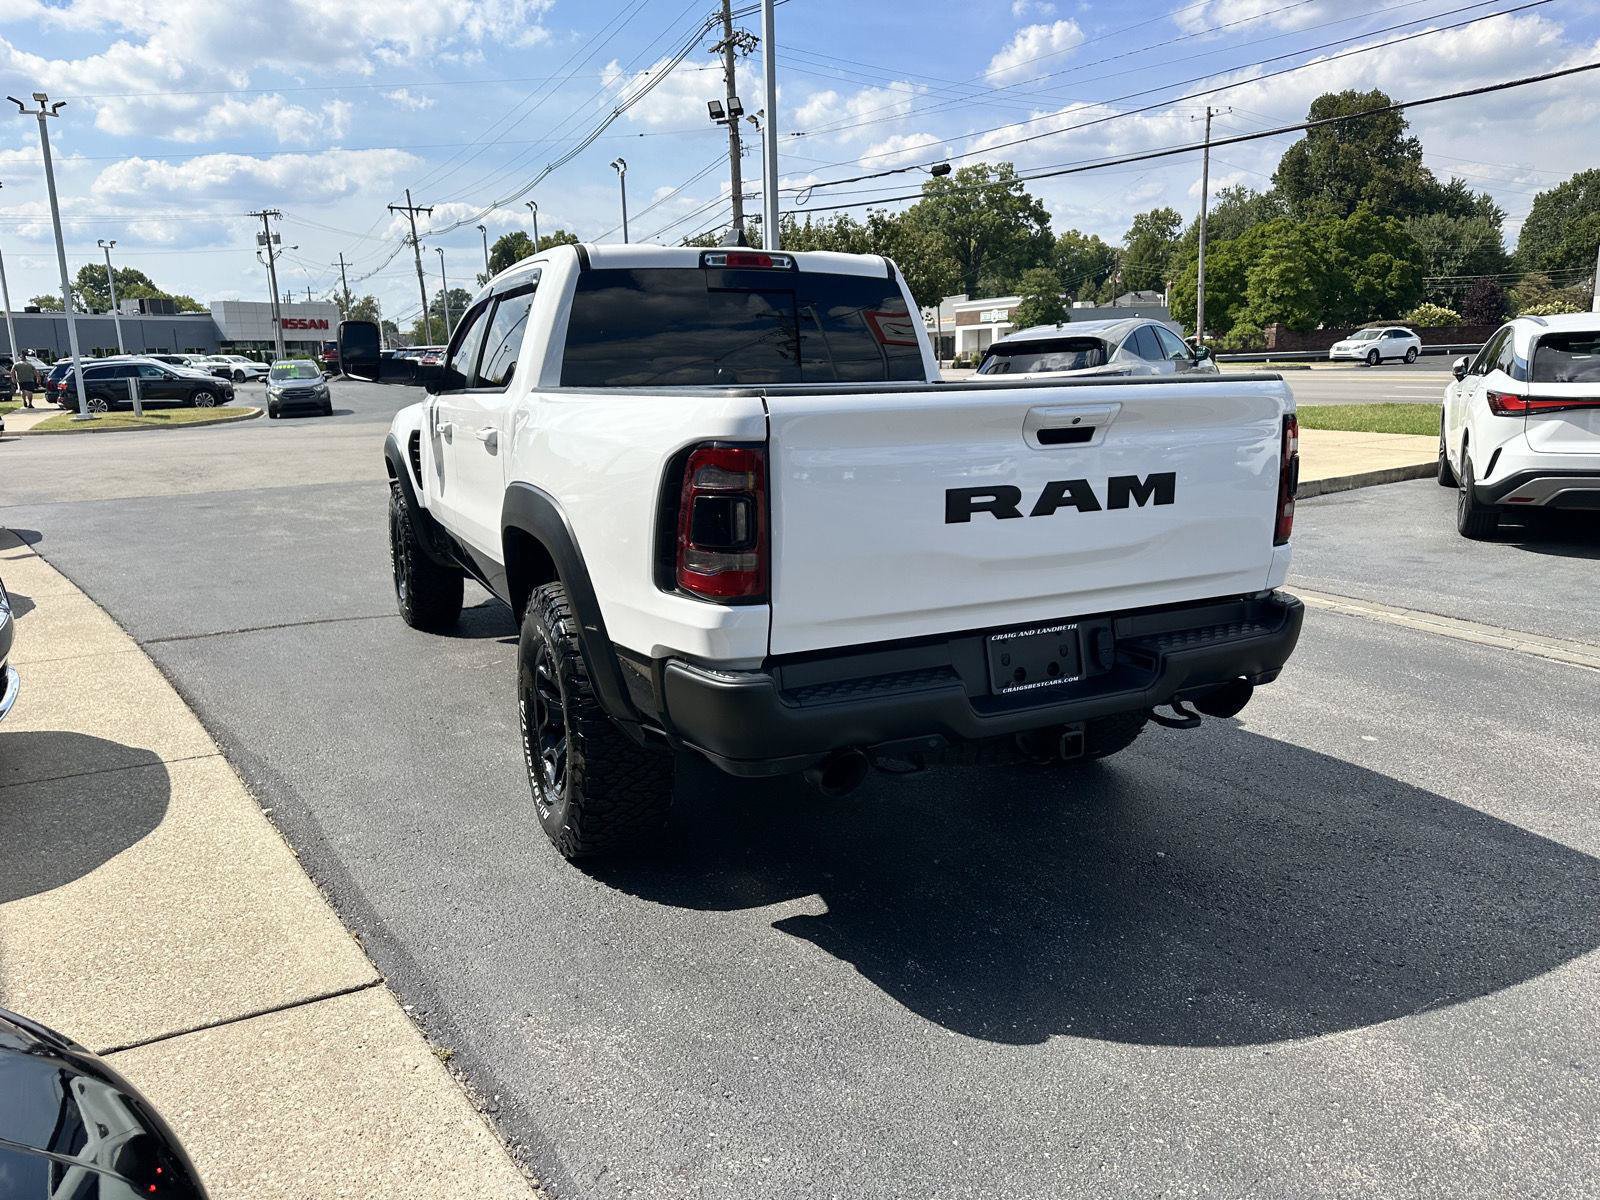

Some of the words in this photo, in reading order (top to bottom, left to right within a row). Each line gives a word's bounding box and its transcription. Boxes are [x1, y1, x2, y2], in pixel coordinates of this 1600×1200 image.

[945, 472, 1176, 524] RAM
[992, 632, 1016, 641] CRAIG
[1018, 629, 1035, 638] AND
[1036, 623, 1078, 635] LANDRETH
[1002, 676, 1079, 693] CRAIGSBESTCARS.COM
